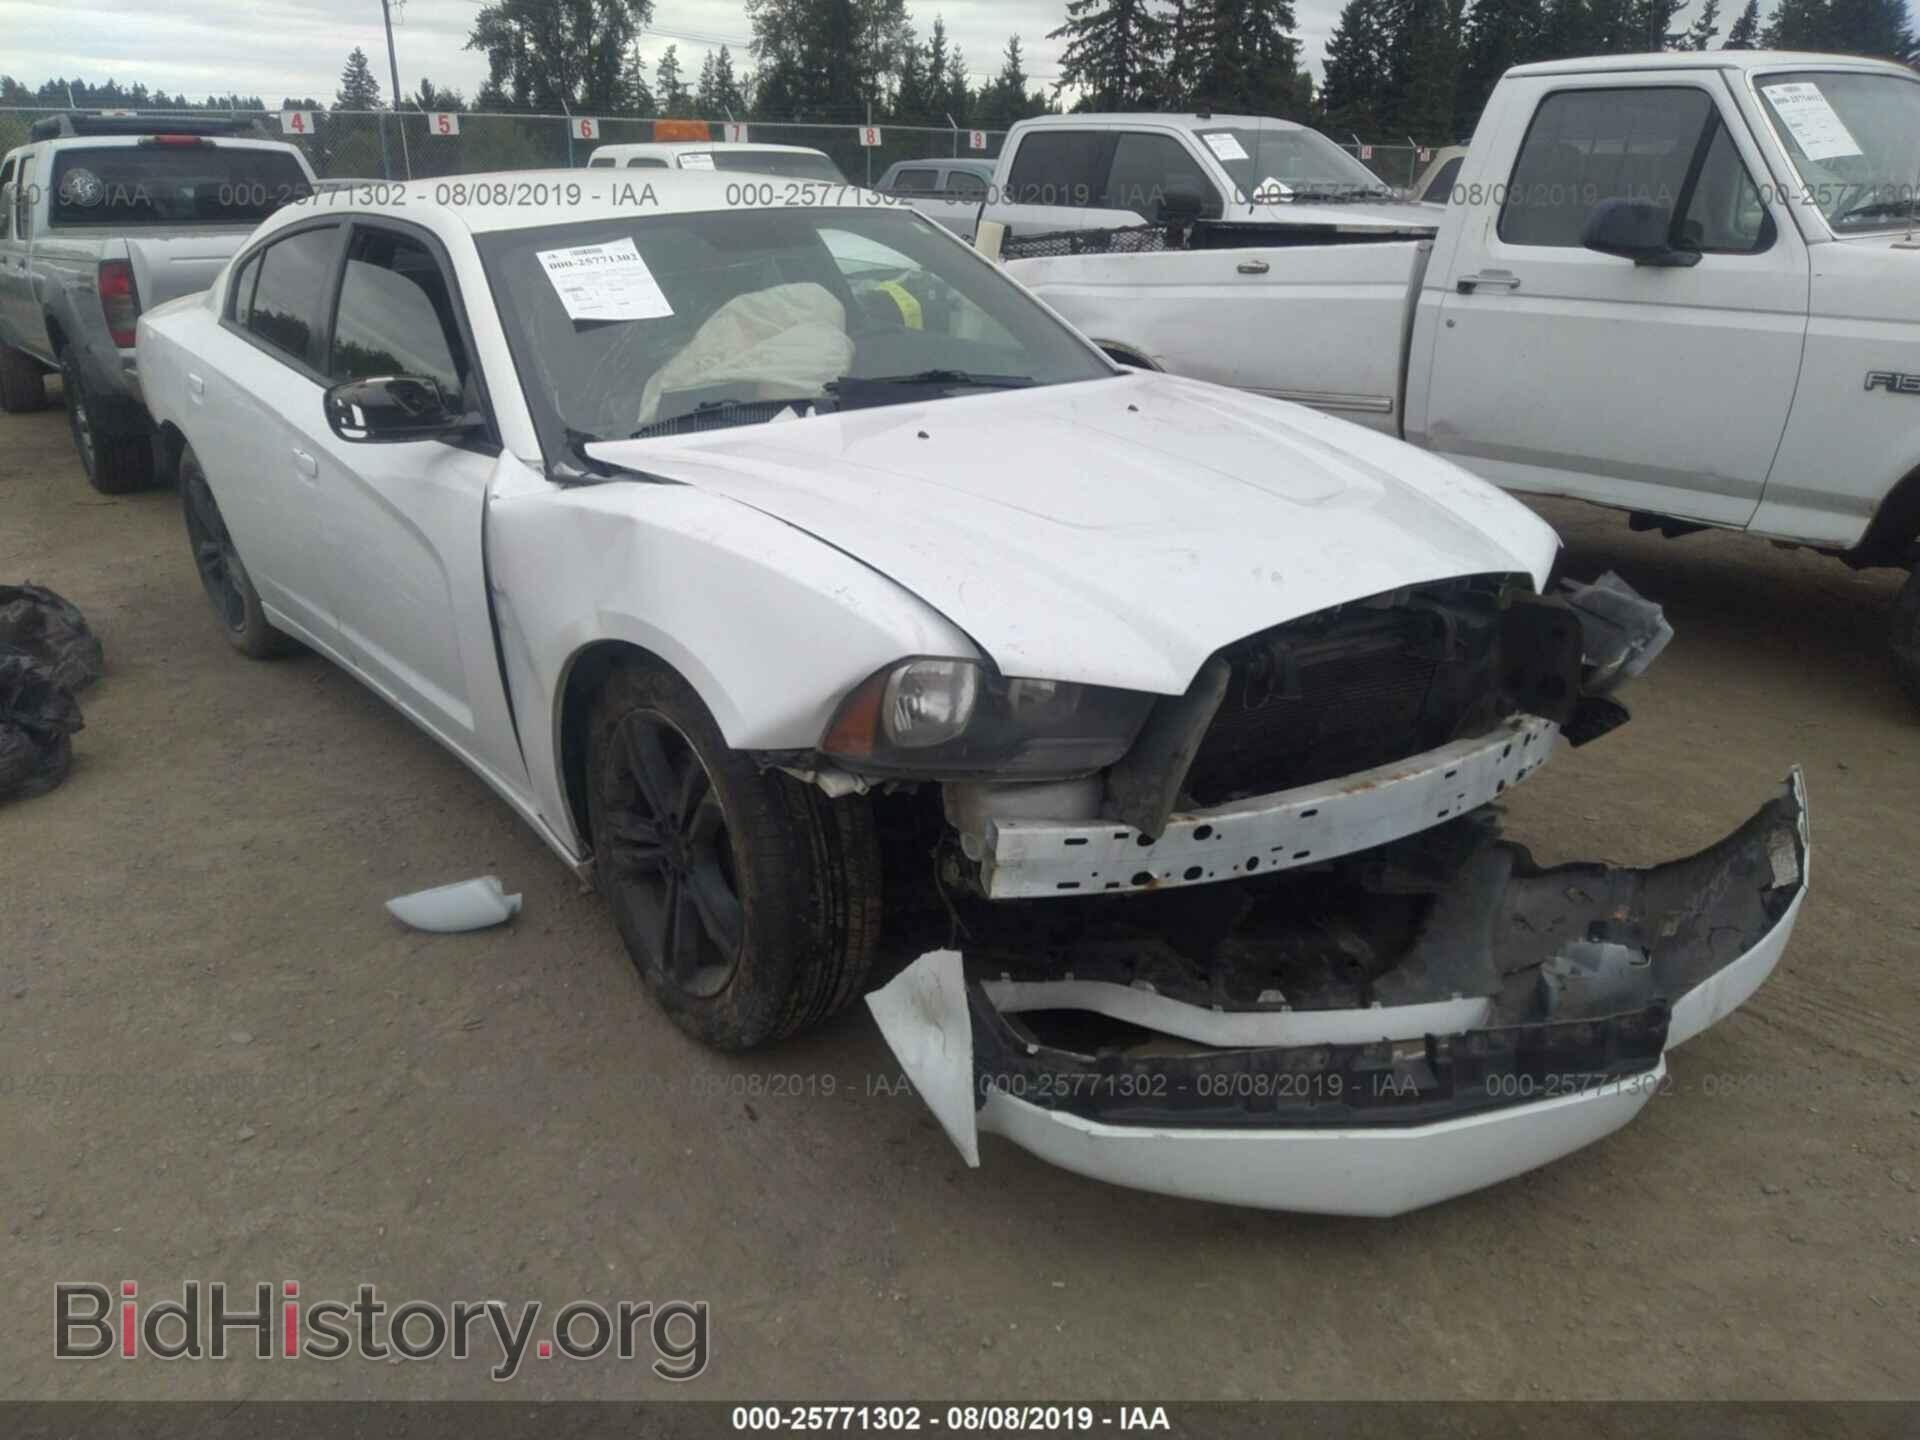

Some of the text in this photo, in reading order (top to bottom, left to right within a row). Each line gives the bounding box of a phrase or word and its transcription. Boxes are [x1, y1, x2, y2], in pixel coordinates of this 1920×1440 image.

[291, 113, 304, 132] 4
[438, 115, 450, 133] 5
[580, 119, 593, 138] 6
[731, 123, 741, 142] 7
[866, 128, 876, 145] 8
